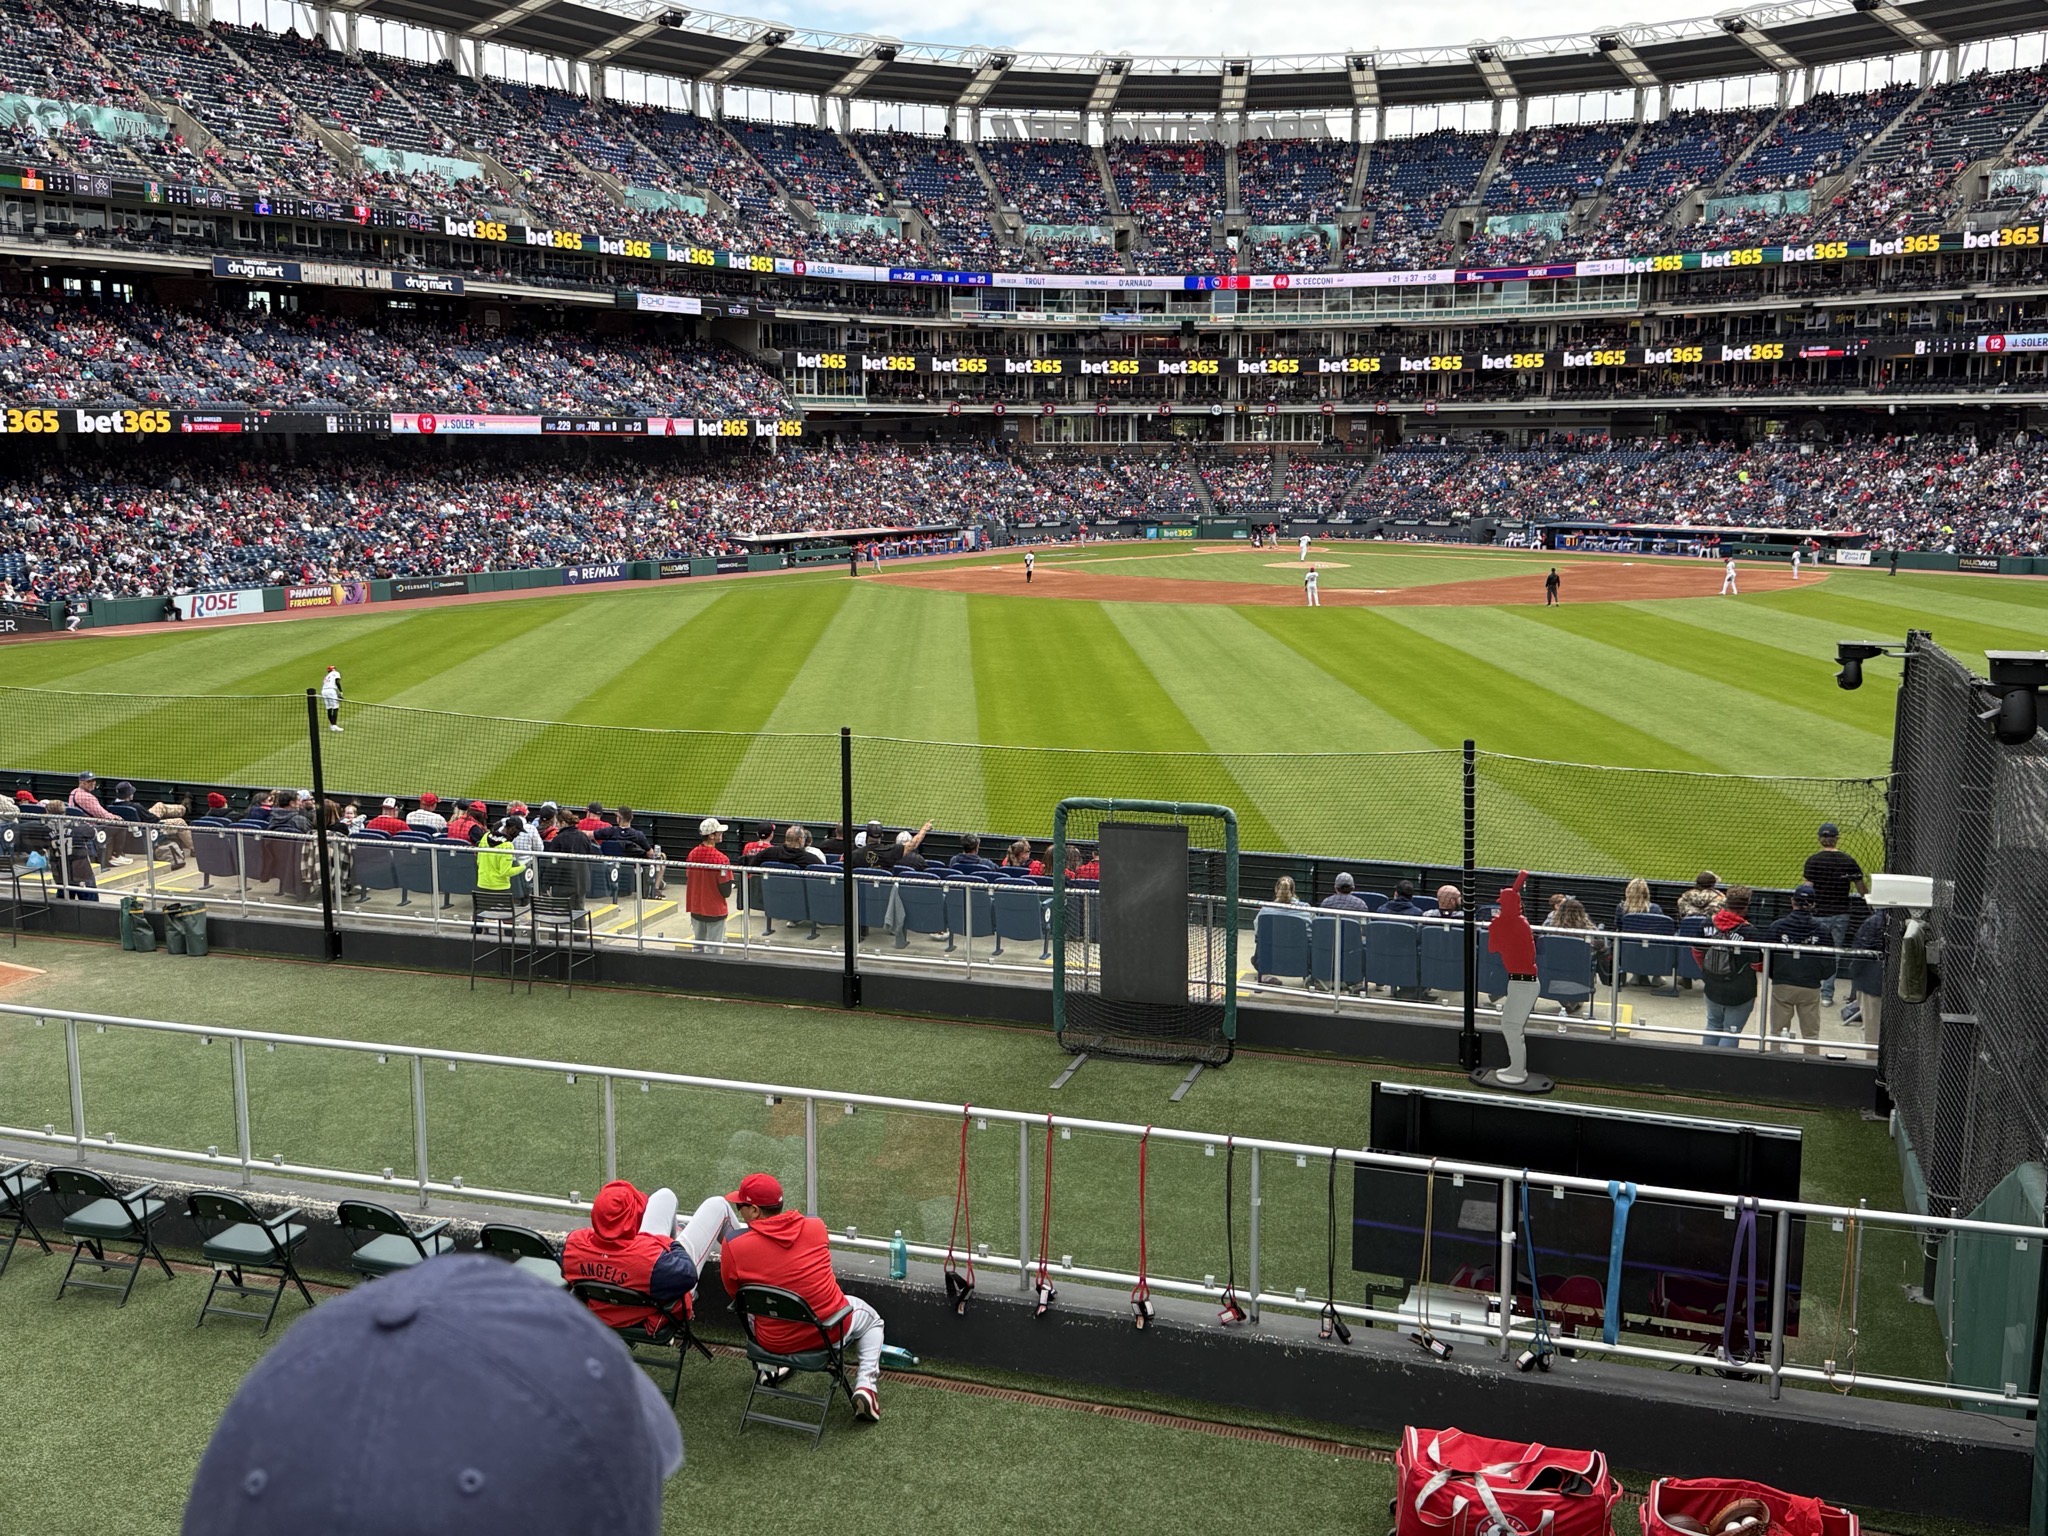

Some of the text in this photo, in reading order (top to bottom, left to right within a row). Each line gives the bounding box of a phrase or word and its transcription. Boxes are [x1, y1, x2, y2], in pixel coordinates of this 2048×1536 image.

[114, 117, 150, 135] WYNN
[1996, 173, 2031, 187] SCORE
[445, 216, 507, 241] bet365
[525, 226, 582, 250] bet365
[1869, 234, 1940, 256] bet365
[1963, 226, 2040, 249] bet365
[600, 236, 651, 258] bet365
[666, 244, 714, 266] bet365
[1782, 242, 1848, 262] bet365
[728, 252, 774, 272] bet365
[1624, 255, 1683, 274] bet365
[1702, 248, 1762, 268] bet365
[228, 262, 284, 278] drug mart
[795, 263, 804, 272] 12
[818, 266, 834, 274] SOLER
[1604, 264, 1615, 272] 1-1
[301, 265, 393, 289] CHAMPIONS CLUB
[405, 277, 452, 292] drug mart
[977, 276, 986, 284] 23
[1025, 278, 1045, 286] TROUT
[1276, 278, 1288, 286] 44
[1410, 274, 1418, 282] 37
[1428, 274, 1436, 282] 58
[1990, 338, 2048, 349] 12 J. SOLER
[797, 352, 846, 369] bet365
[1563, 350, 1626, 367] bet365
[1644, 346, 1703, 364] bet365
[1721, 344, 1784, 362] bet365
[862, 355, 915, 370] bet365
[932, 356, 987, 372] bet365
[1005, 358, 1062, 374] bet365
[1080, 360, 1139, 374] bet365
[1158, 360, 1218, 374] bet365
[1238, 359, 1299, 374] bet365
[1318, 358, 1380, 372] bet365
[1400, 356, 1462, 371] bet365
[1482, 354, 1544, 369] bet365
[76, 410, 171, 433] bet365
[384, 420, 389, 429] 2
[422, 418, 432, 429] 12
[443, 420, 450, 429] J.
[451, 419, 475, 429] SOLER
[556, 421, 570, 430] .229
[586, 421, 600, 431] .708
[612, 422, 616, 431] 8
[633, 421, 642, 431] 23
[699, 420, 748, 436] bet365
[756, 420, 802, 436] bet365
[1163, 528, 1192, 537] bet365
[582, 565, 620, 579] RE/MAX
[289, 587, 331, 598] PHANTOM
[191, 593, 238, 618] ROSE
[289, 597, 331, 608] FIREWORKS
[580, 1263, 628, 1284] ANGELS
